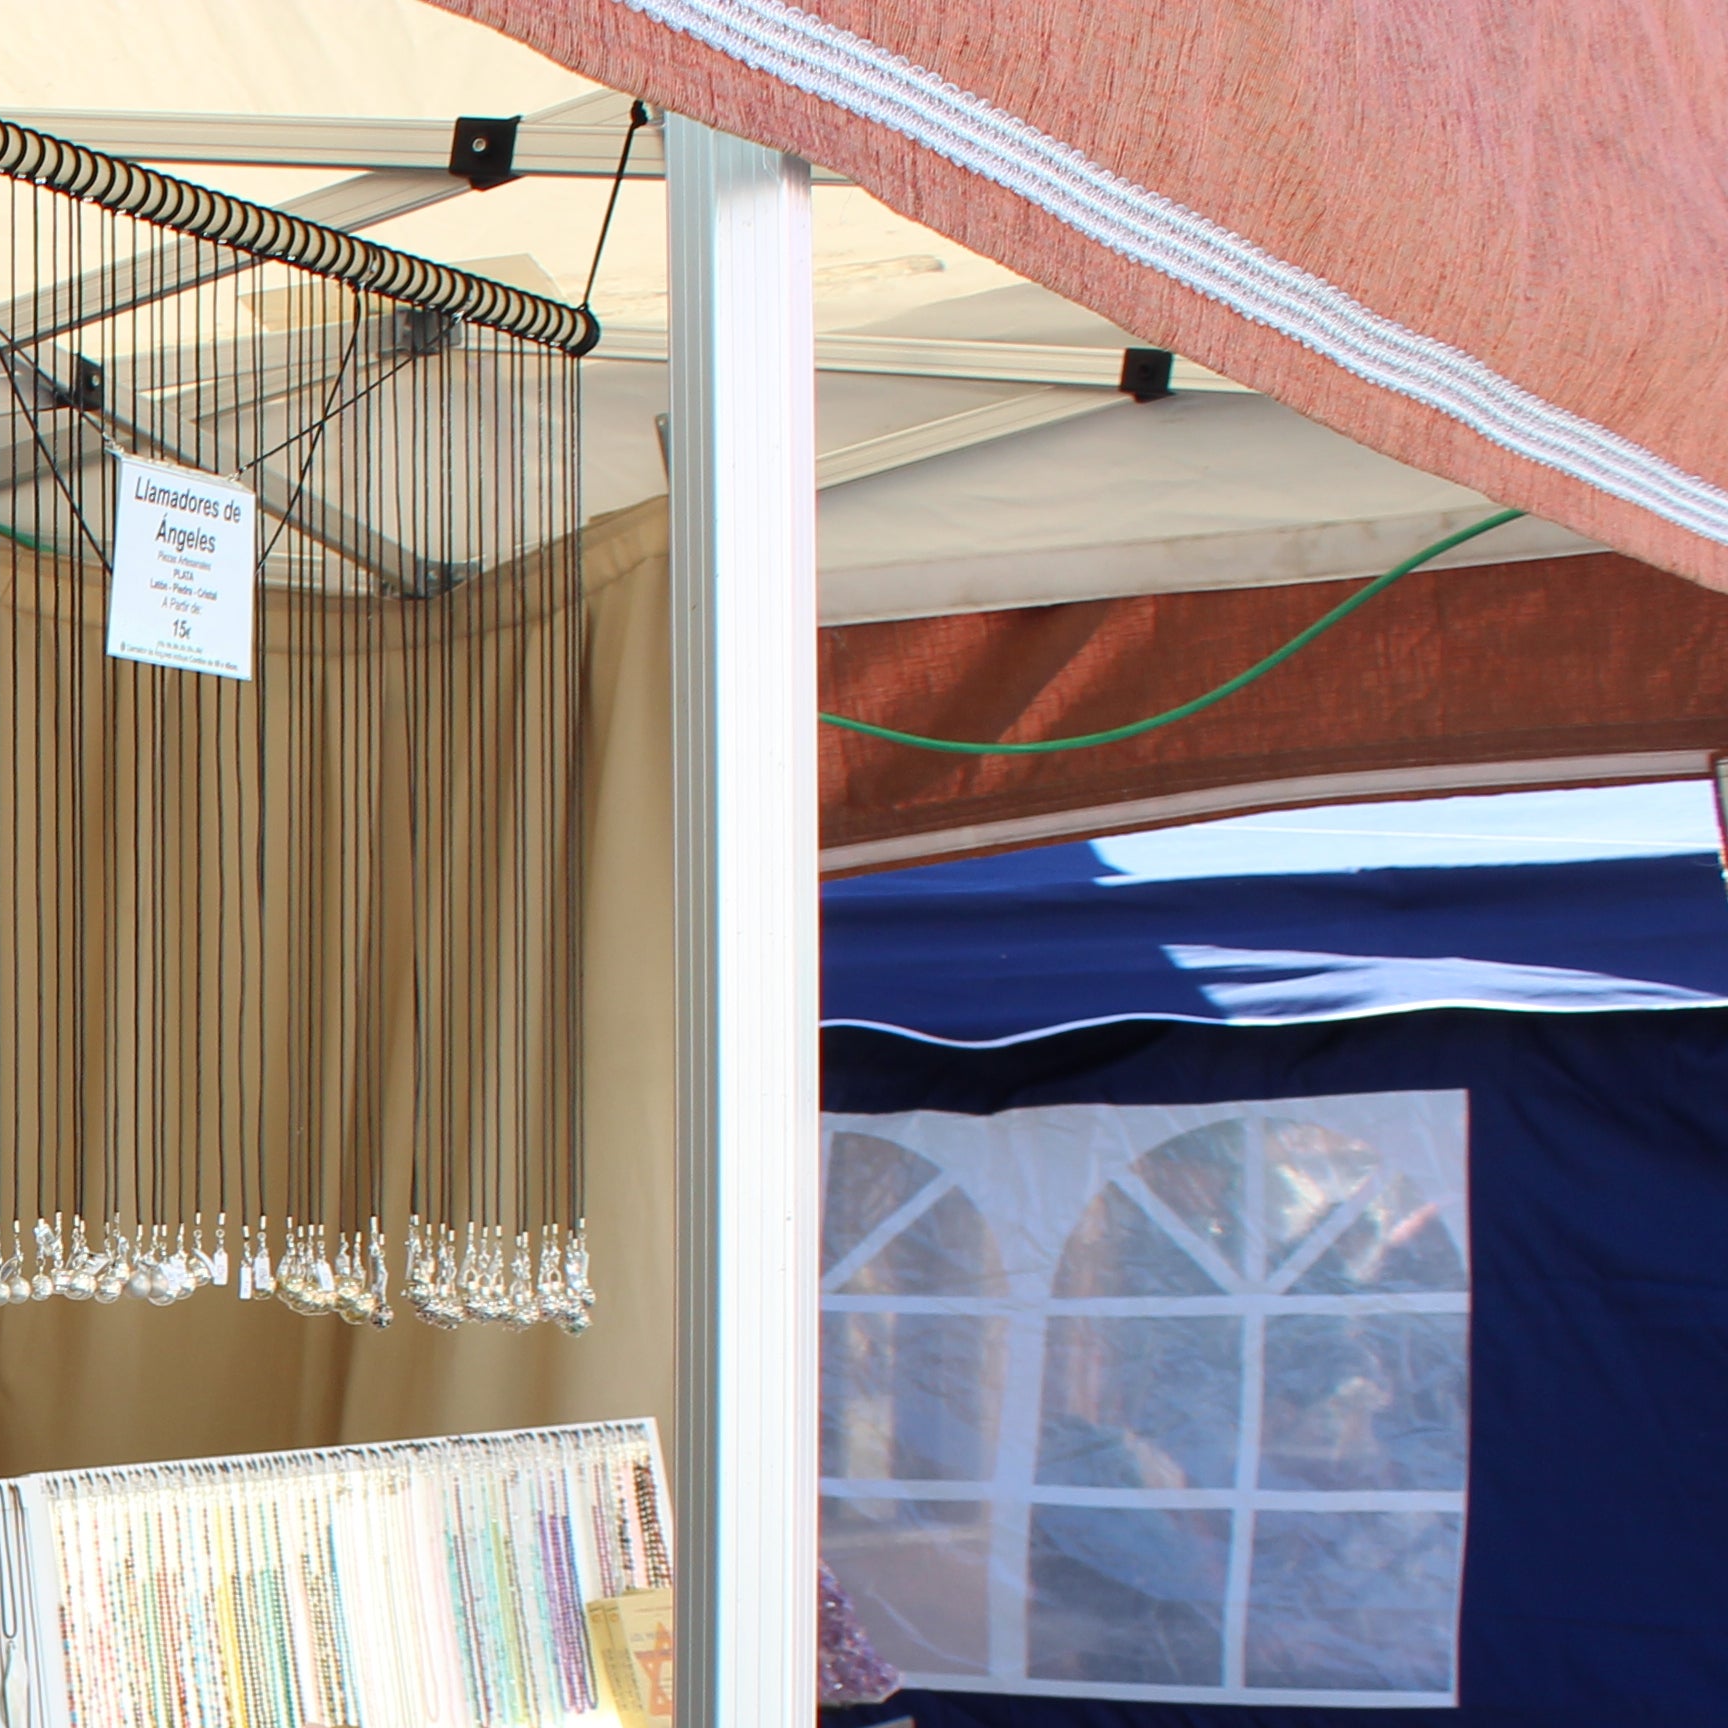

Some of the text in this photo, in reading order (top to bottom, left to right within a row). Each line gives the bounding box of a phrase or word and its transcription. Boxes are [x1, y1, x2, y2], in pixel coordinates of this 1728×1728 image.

[134, 476, 241, 523] Llamadores de
[155, 513, 216, 553] Ángeles
[173, 569, 194, 582] PLATA
[173, 618, 191, 640] 15€
